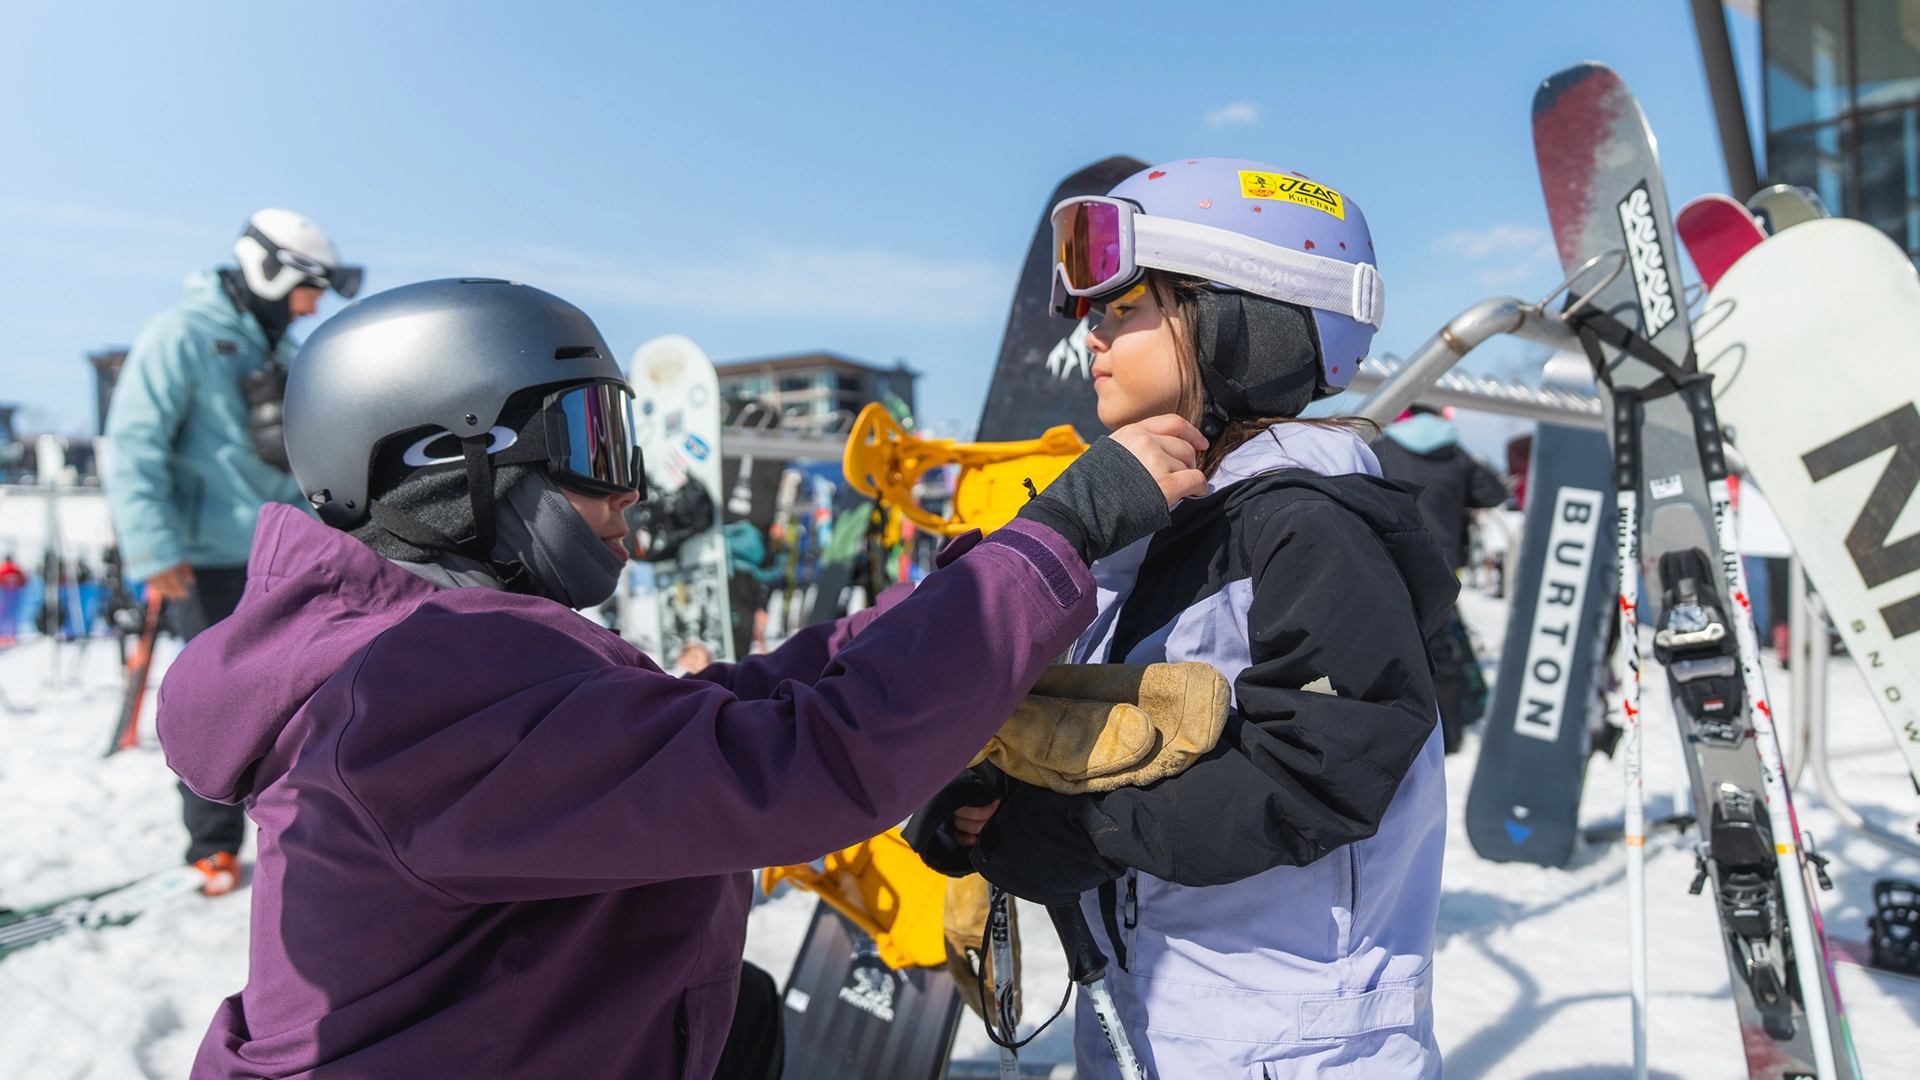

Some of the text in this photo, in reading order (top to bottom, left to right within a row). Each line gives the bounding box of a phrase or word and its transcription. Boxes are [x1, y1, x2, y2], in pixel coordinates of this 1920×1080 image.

[1288, 193, 1336, 213] Kutchan
[1203, 251, 1307, 288] ATOMIC
[1523, 501, 1592, 727] BURTON
